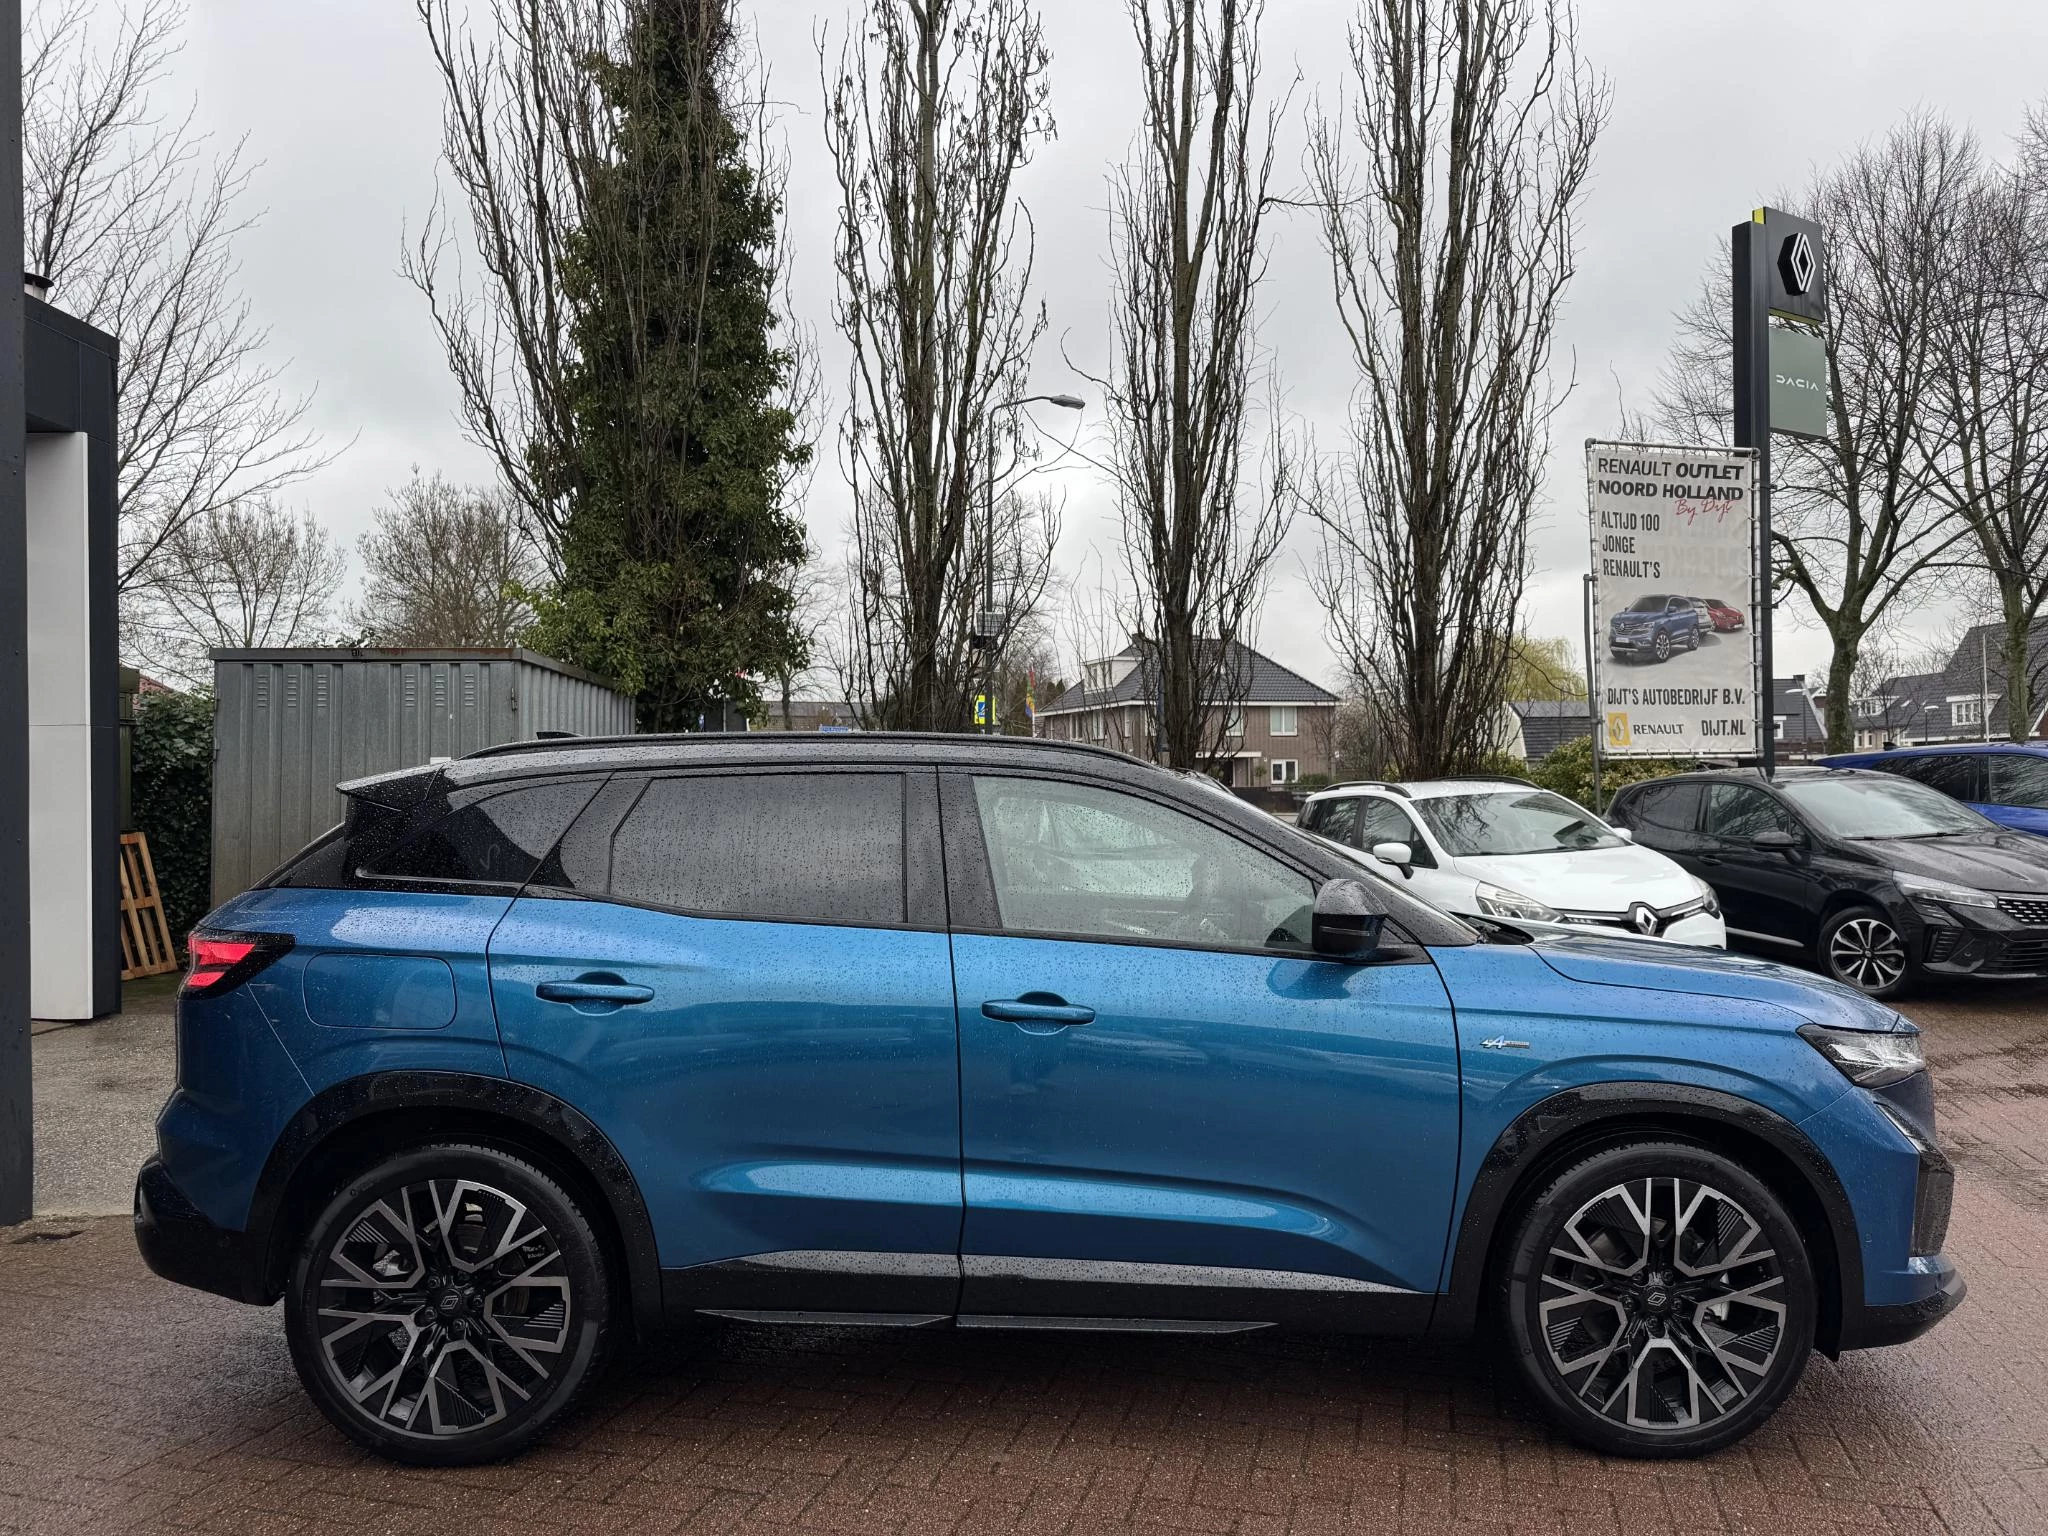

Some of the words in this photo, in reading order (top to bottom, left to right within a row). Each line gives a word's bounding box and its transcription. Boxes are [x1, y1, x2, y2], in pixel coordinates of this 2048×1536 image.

[1776, 374, 1819, 392] DACIA
[1598, 457, 1671, 477] RENAULT
[1675, 463, 1744, 480] OUTLET
[1598, 480, 1657, 497] NOORD
[1663, 484, 1744, 501] HOLLAND
[1601, 511, 1637, 531] ALTIJD
[1641, 513, 1660, 531] 100
[1675, 499, 1698, 526] By
[1602, 535, 1635, 554] JONGE
[1603, 559, 1660, 579] RENAULT'S
[1607, 688, 1639, 705] DIJT'S
[1642, 688, 1719, 705] AUTOBEDRIJF
[1722, 688, 1746, 705] B.V.
[1633, 723, 1684, 735] RENAULT
[1701, 719, 1746, 737] DIJT.NL
